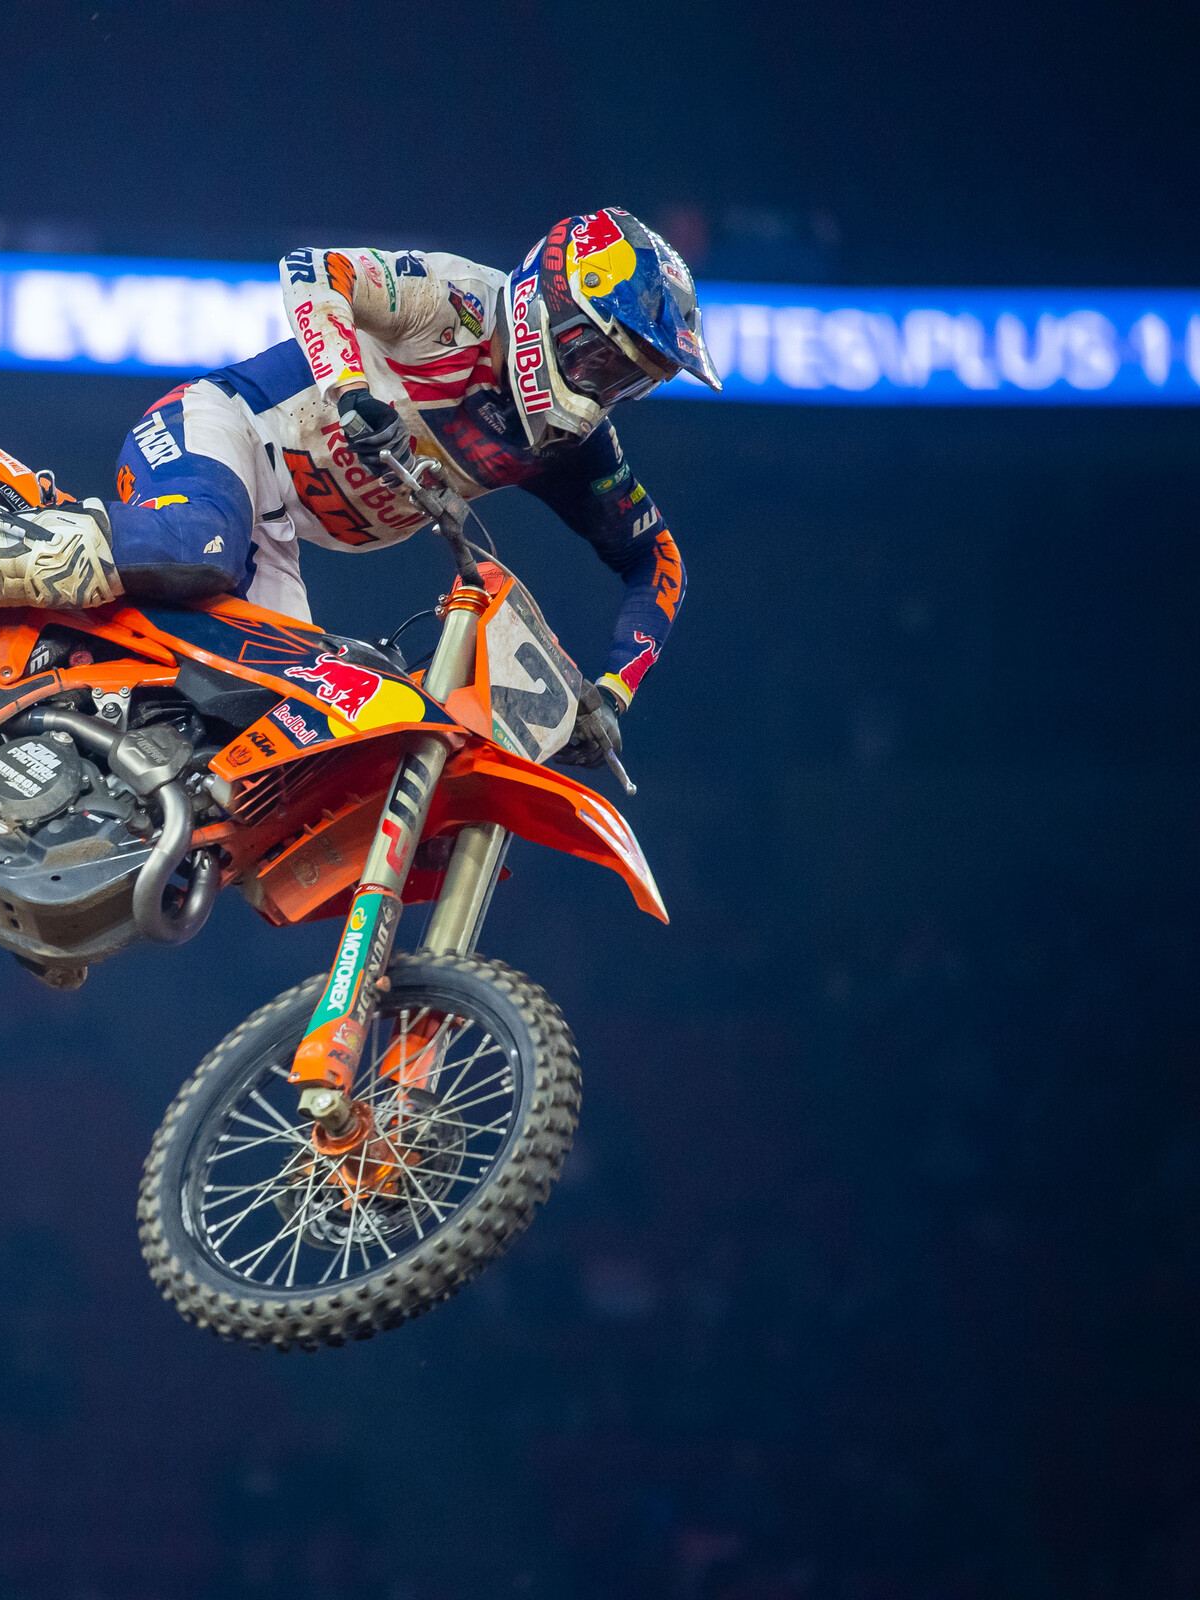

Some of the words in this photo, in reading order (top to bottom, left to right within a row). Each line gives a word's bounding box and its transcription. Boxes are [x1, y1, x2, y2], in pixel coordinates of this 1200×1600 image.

[12, 268, 286, 367] EVENT
[1129, 311, 1172, 388] 1
[0, 484, 20, 506] LOMA
[491, 641, 569, 762] 2
[19, 741, 62, 769] KTM
[246, 731, 277, 758] KTM
[7, 747, 57, 778] FACTORY
[327, 932, 363, 1015] MOTOREX
